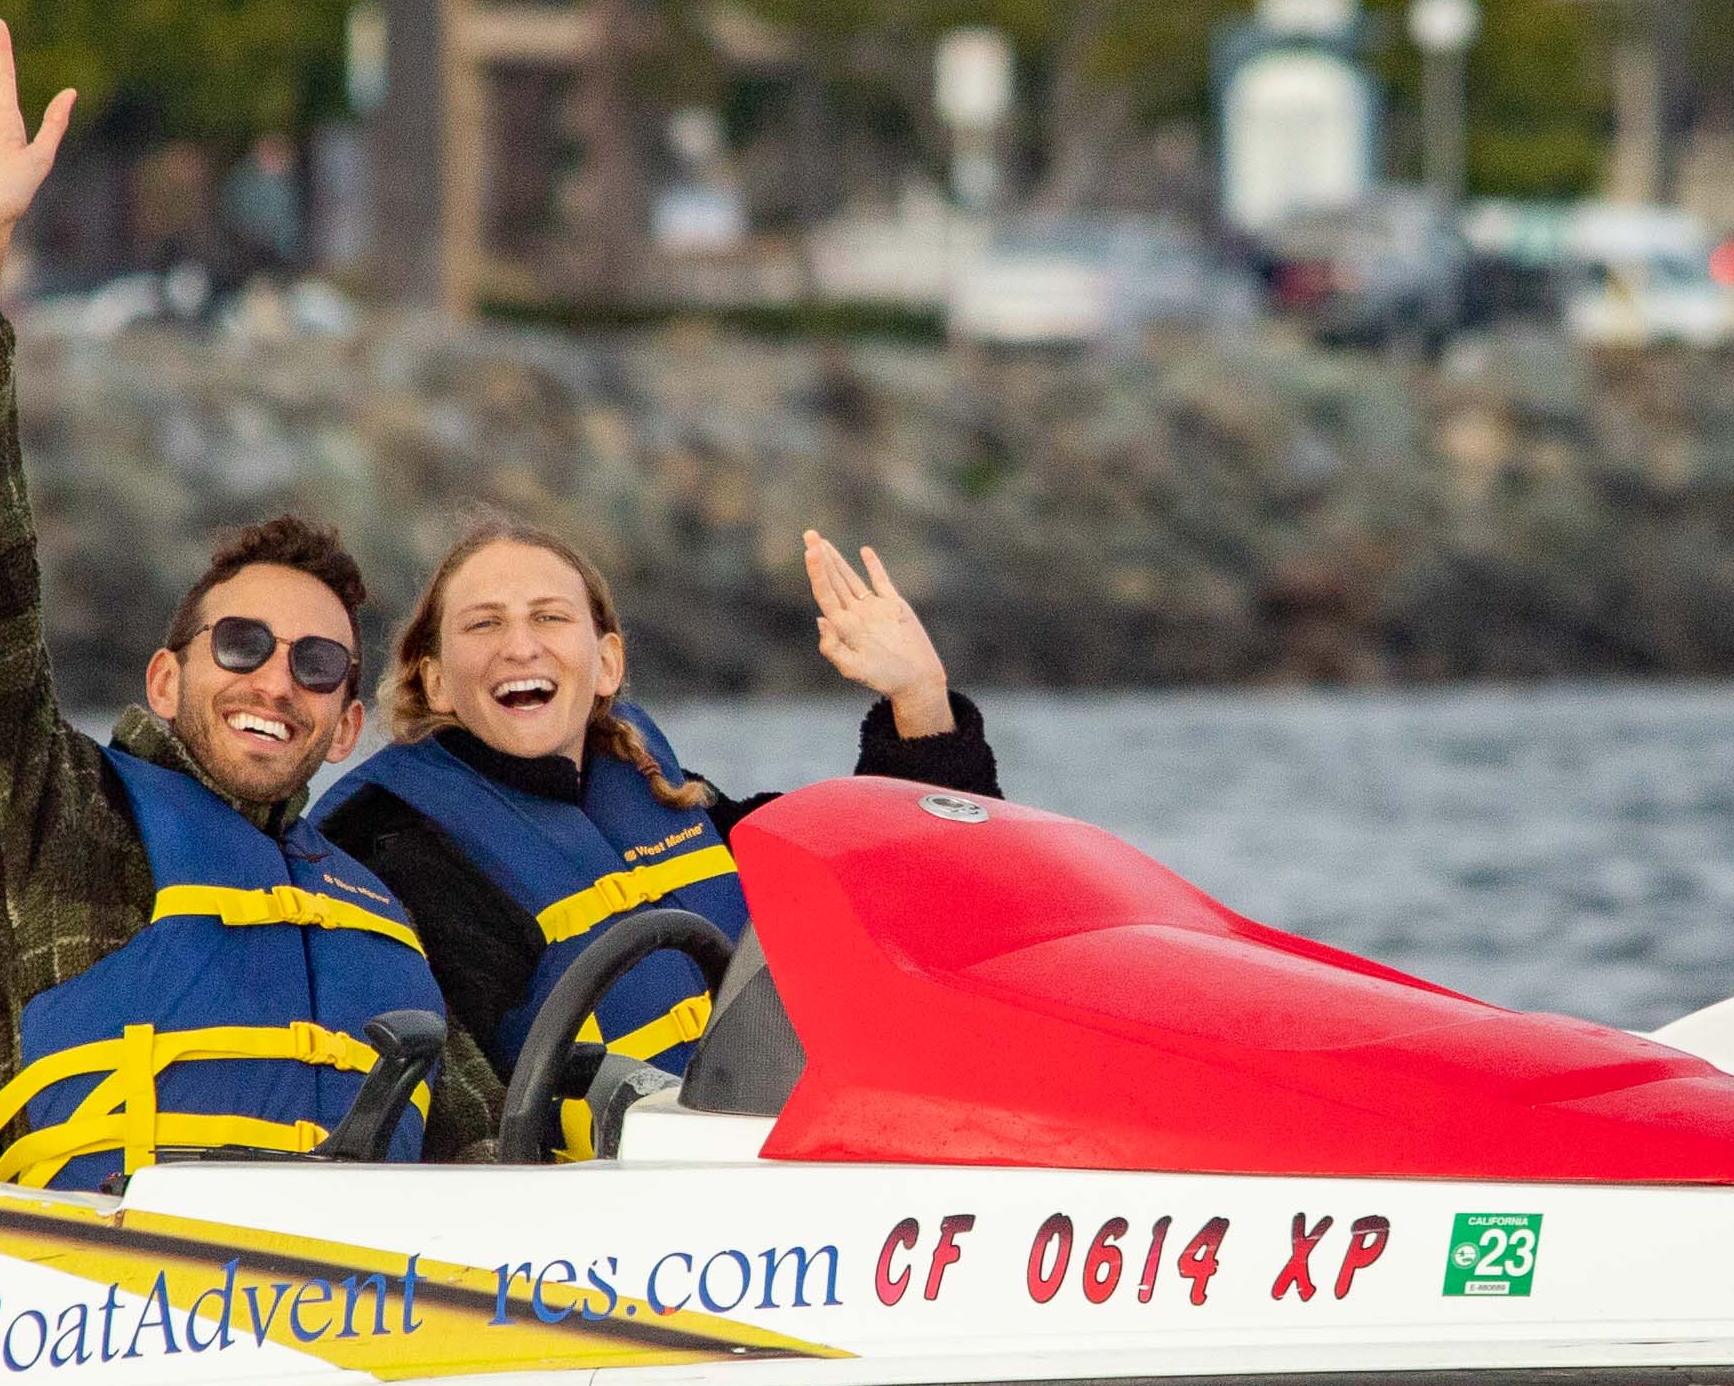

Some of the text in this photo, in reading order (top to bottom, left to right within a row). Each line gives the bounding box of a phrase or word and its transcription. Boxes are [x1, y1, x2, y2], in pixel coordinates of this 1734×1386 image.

[1467, 1216, 1529, 1226] CALIFORNIA
[874, 1212, 1391, 1307] CF 0614 XP
[1473, 1228, 1536, 1277] 23
